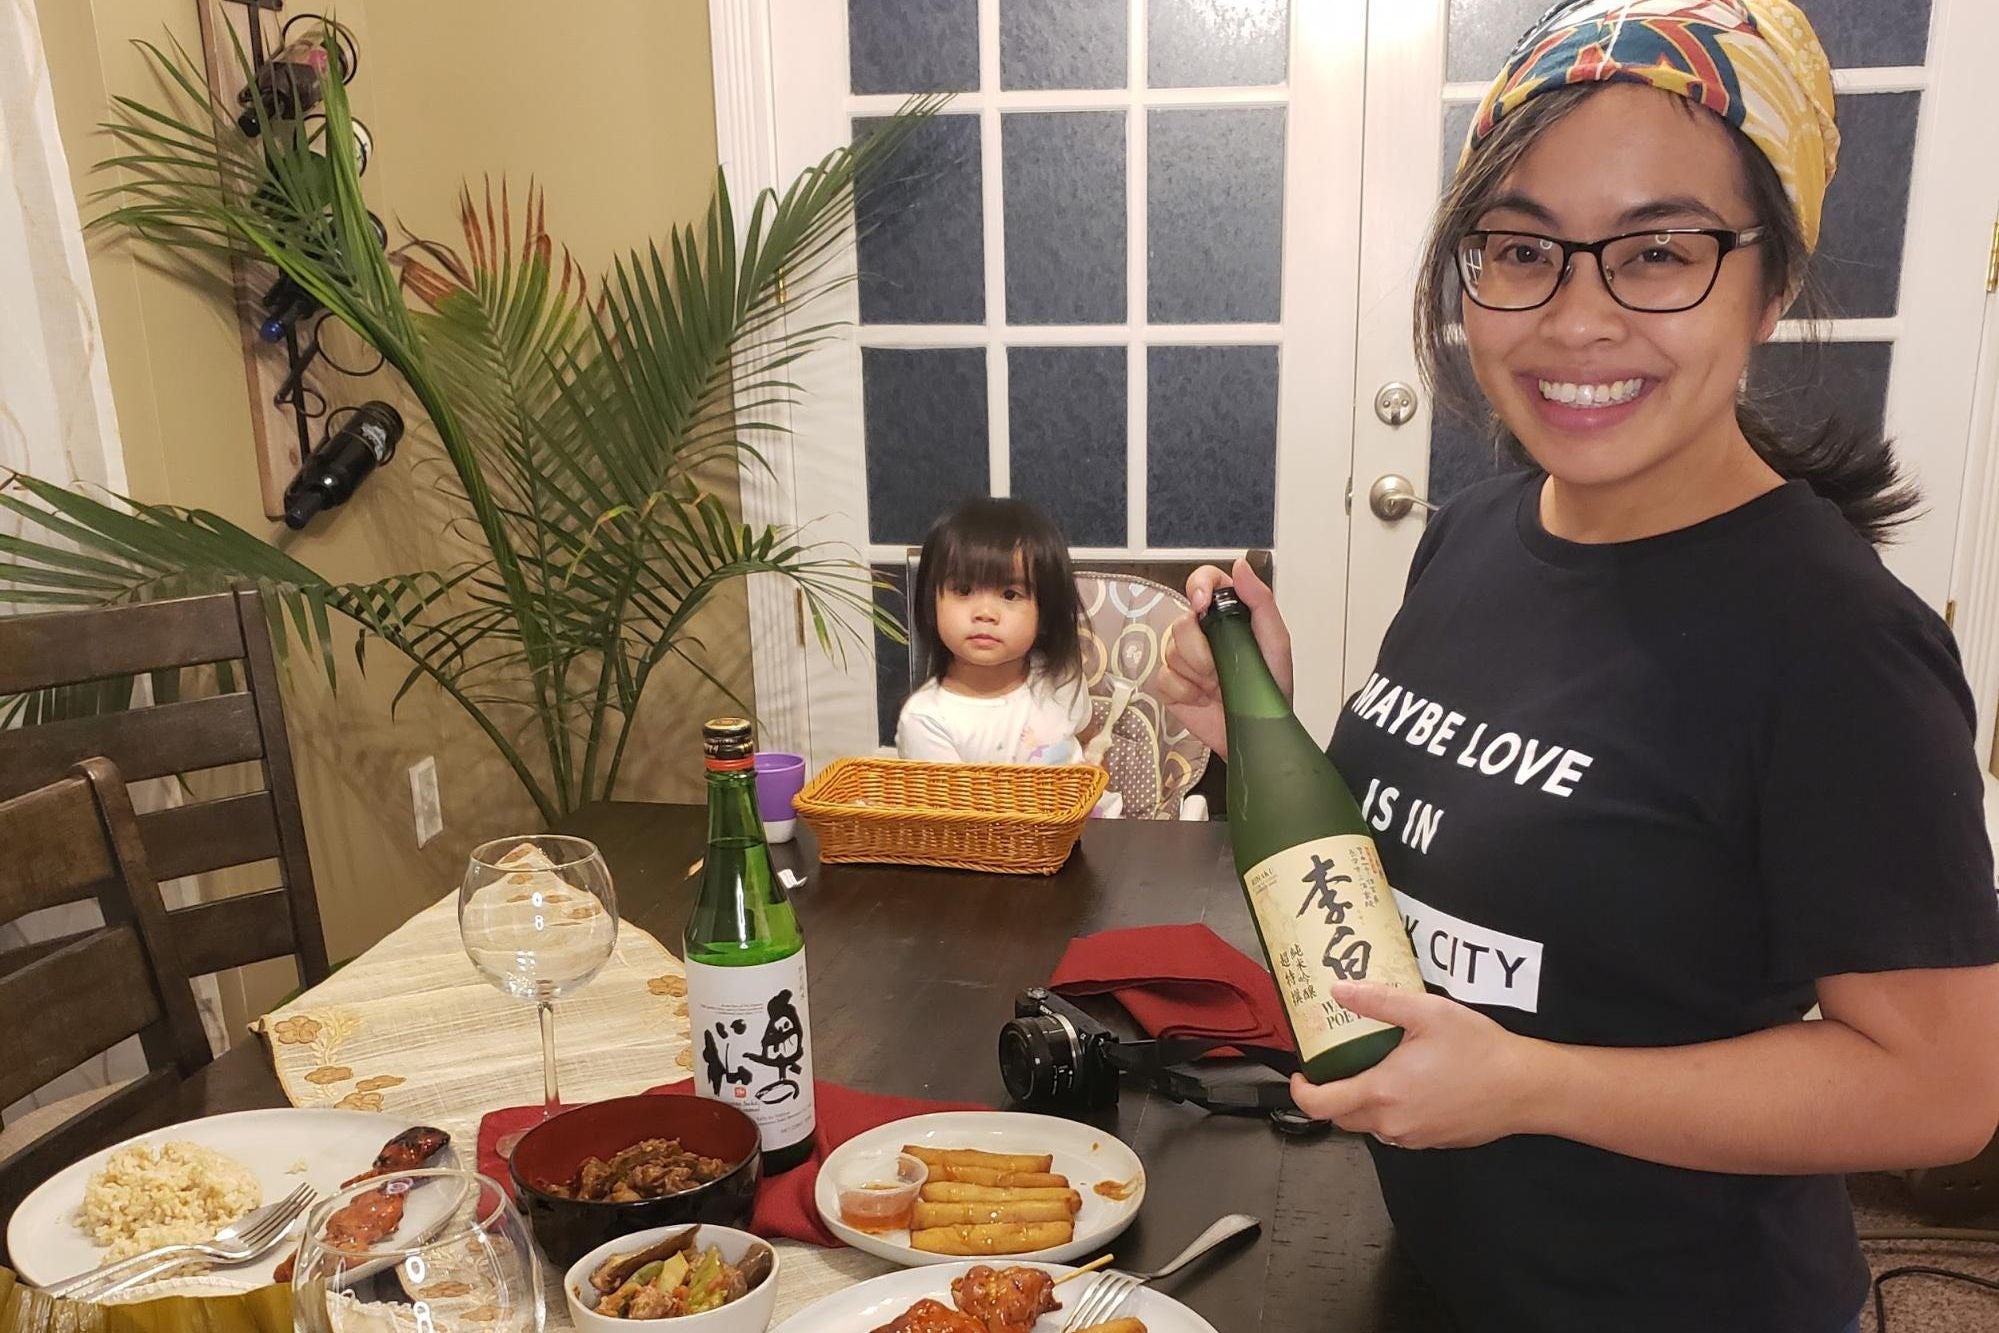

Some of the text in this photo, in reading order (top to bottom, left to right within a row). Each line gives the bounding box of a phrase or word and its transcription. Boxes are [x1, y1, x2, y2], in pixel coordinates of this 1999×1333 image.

[1351, 672, 1594, 798] MAYBE LOVE
[1361, 778, 1445, 855] IS IN
[1296, 853, 1374, 980] 李白
[1429, 929, 1527, 989] CITY
[1326, 1009, 1361, 1030] POE
